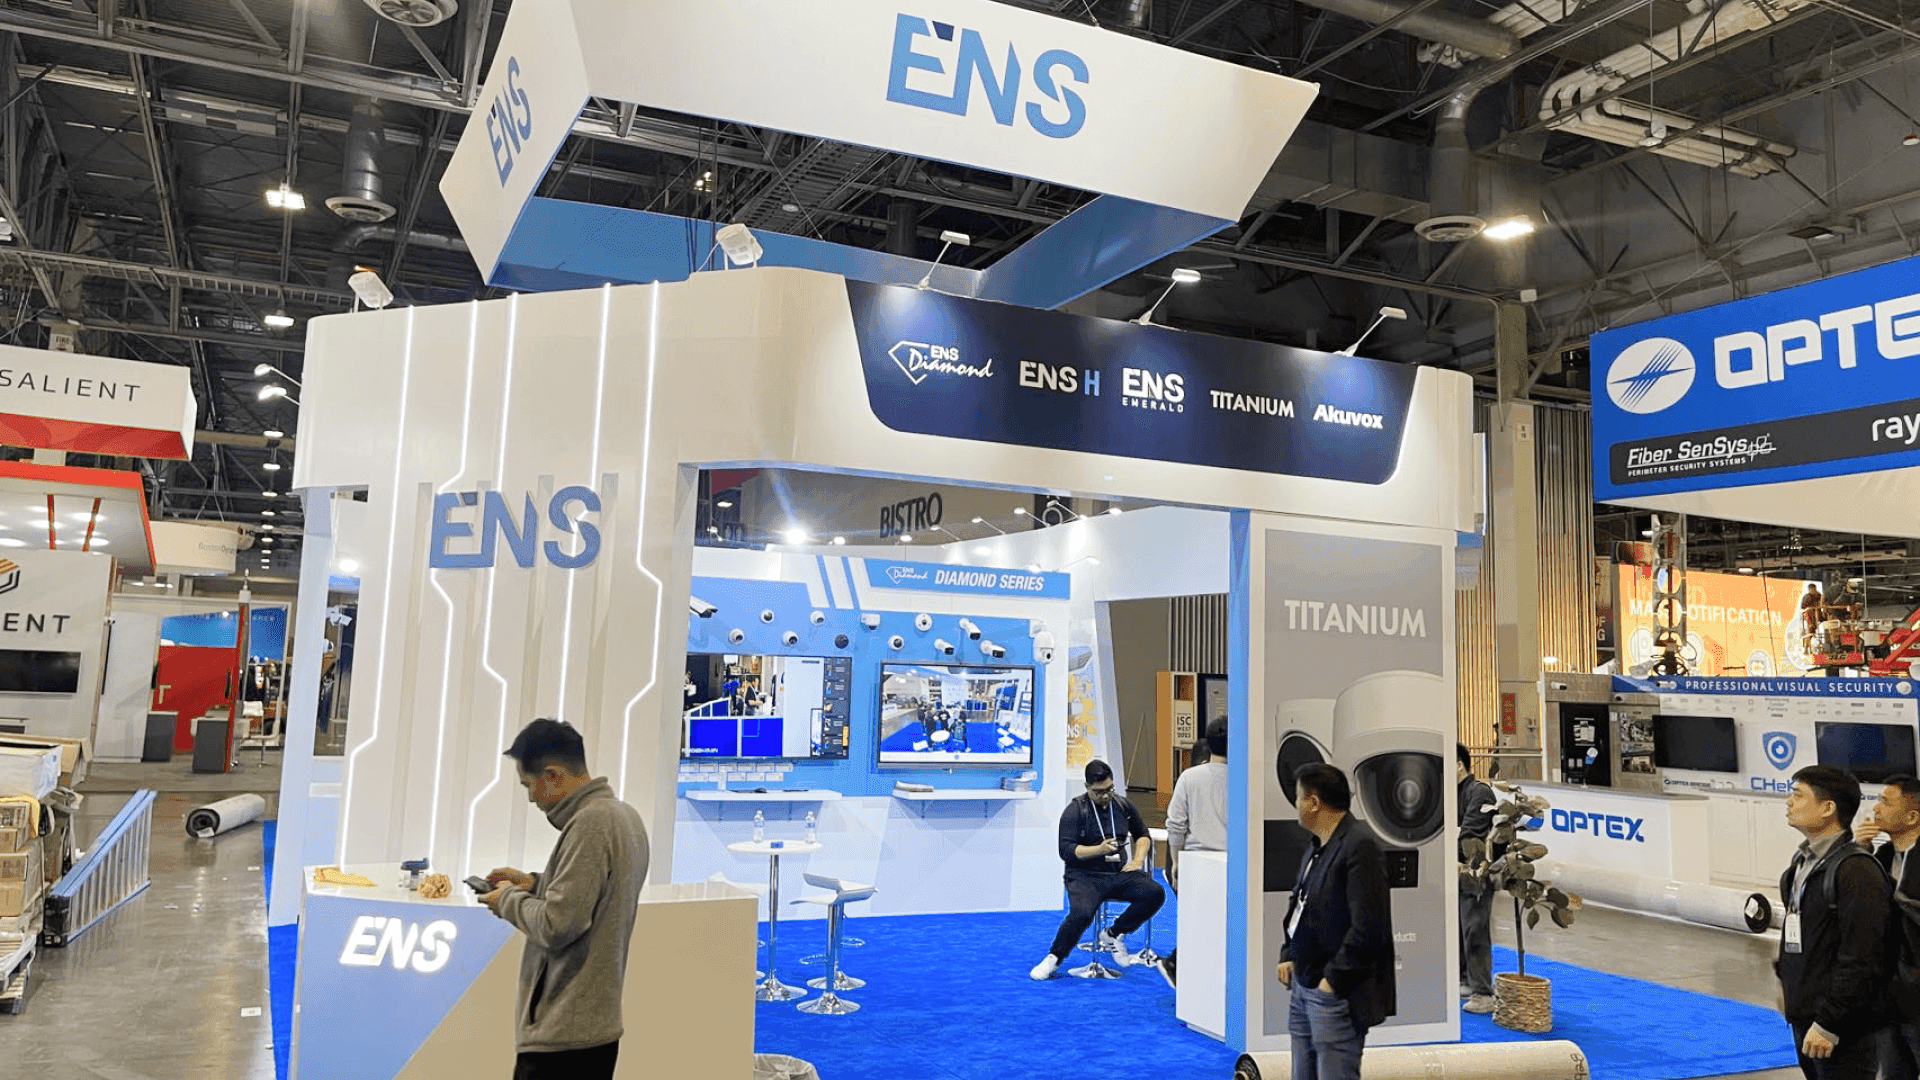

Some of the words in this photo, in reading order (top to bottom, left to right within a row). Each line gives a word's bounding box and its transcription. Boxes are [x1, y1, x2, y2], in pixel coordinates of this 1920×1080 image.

[886, 12, 1090, 139] ENS
[486, 56, 531, 188] ENS
[930, 344, 959, 361] ENS
[1713, 293, 1920, 390] OPTE
[908, 347, 994, 378] Diamond
[0, 369, 141, 402] SALIENT
[1019, 360, 1078, 393] ENS
[1084, 369, 1100, 397] H
[1122, 367, 1185, 403] ENS
[1121, 396, 1185, 413] EMERALD
[1209, 389, 1295, 418] TITANIUM
[1312, 403, 1384, 430] Akuvox
[1871, 412, 1920, 445] ray
[1628, 446, 1673, 467] Fiber
[1677, 436, 1748, 458] SenSys
[1628, 466, 1668, 477] PERIMETER
[1669, 461, 1706, 472] SECURITY
[1708, 456, 1746, 468] SYSTEMS
[429, 486, 602, 569] ENS
[880, 492, 943, 538] BISTRO
[934, 569, 997, 588] DIAMOND
[999, 574, 1045, 592] SERIES
[3, 612, 71, 634] ENT
[1284, 599, 1426, 638] TITANIUM
[1685, 680, 1774, 692] PROFESSIONAL
[1776, 681, 1821, 693] VISUAL
[1829, 682, 1893, 694] SECURITY
[1067, 724, 1080, 738] NS
[1176, 716, 1192, 726] ISC
[1750, 776, 1794, 793] CHeK
[1551, 808, 1645, 843] OPTEX
[339, 916, 458, 974] ENS
